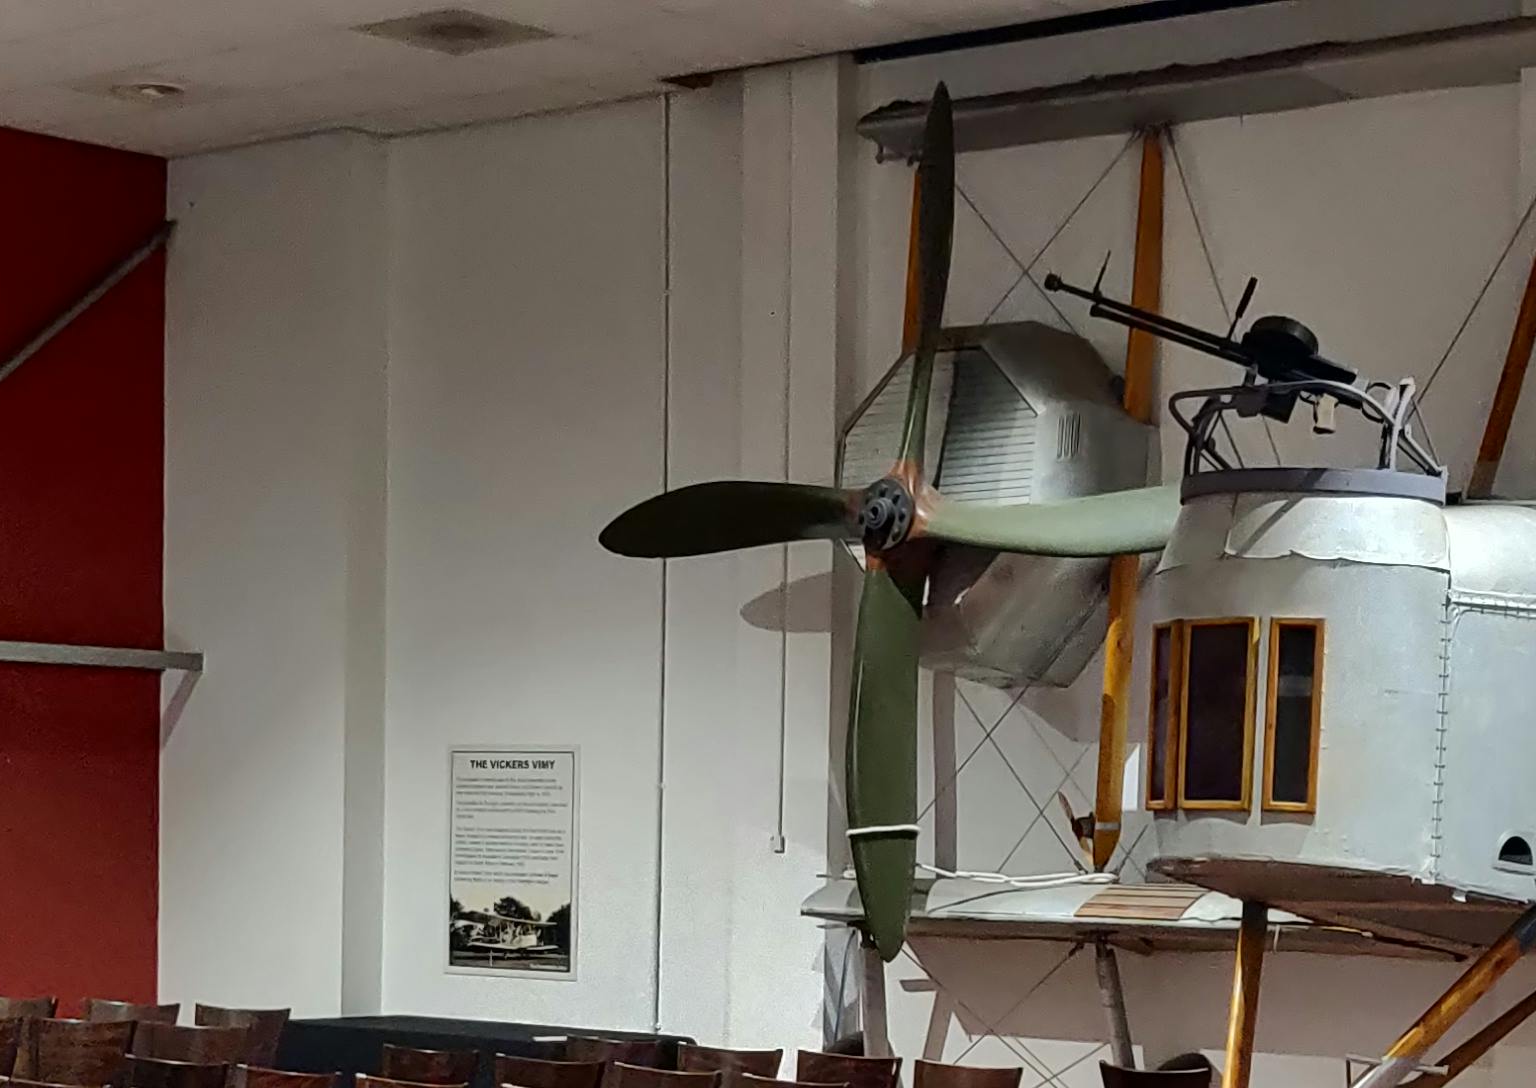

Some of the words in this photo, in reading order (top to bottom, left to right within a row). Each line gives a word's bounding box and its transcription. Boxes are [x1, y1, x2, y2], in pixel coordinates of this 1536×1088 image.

[470, 760, 488, 769] THE
[490, 760, 530, 769] VICKERS
[532, 760, 555, 769] VIMY
